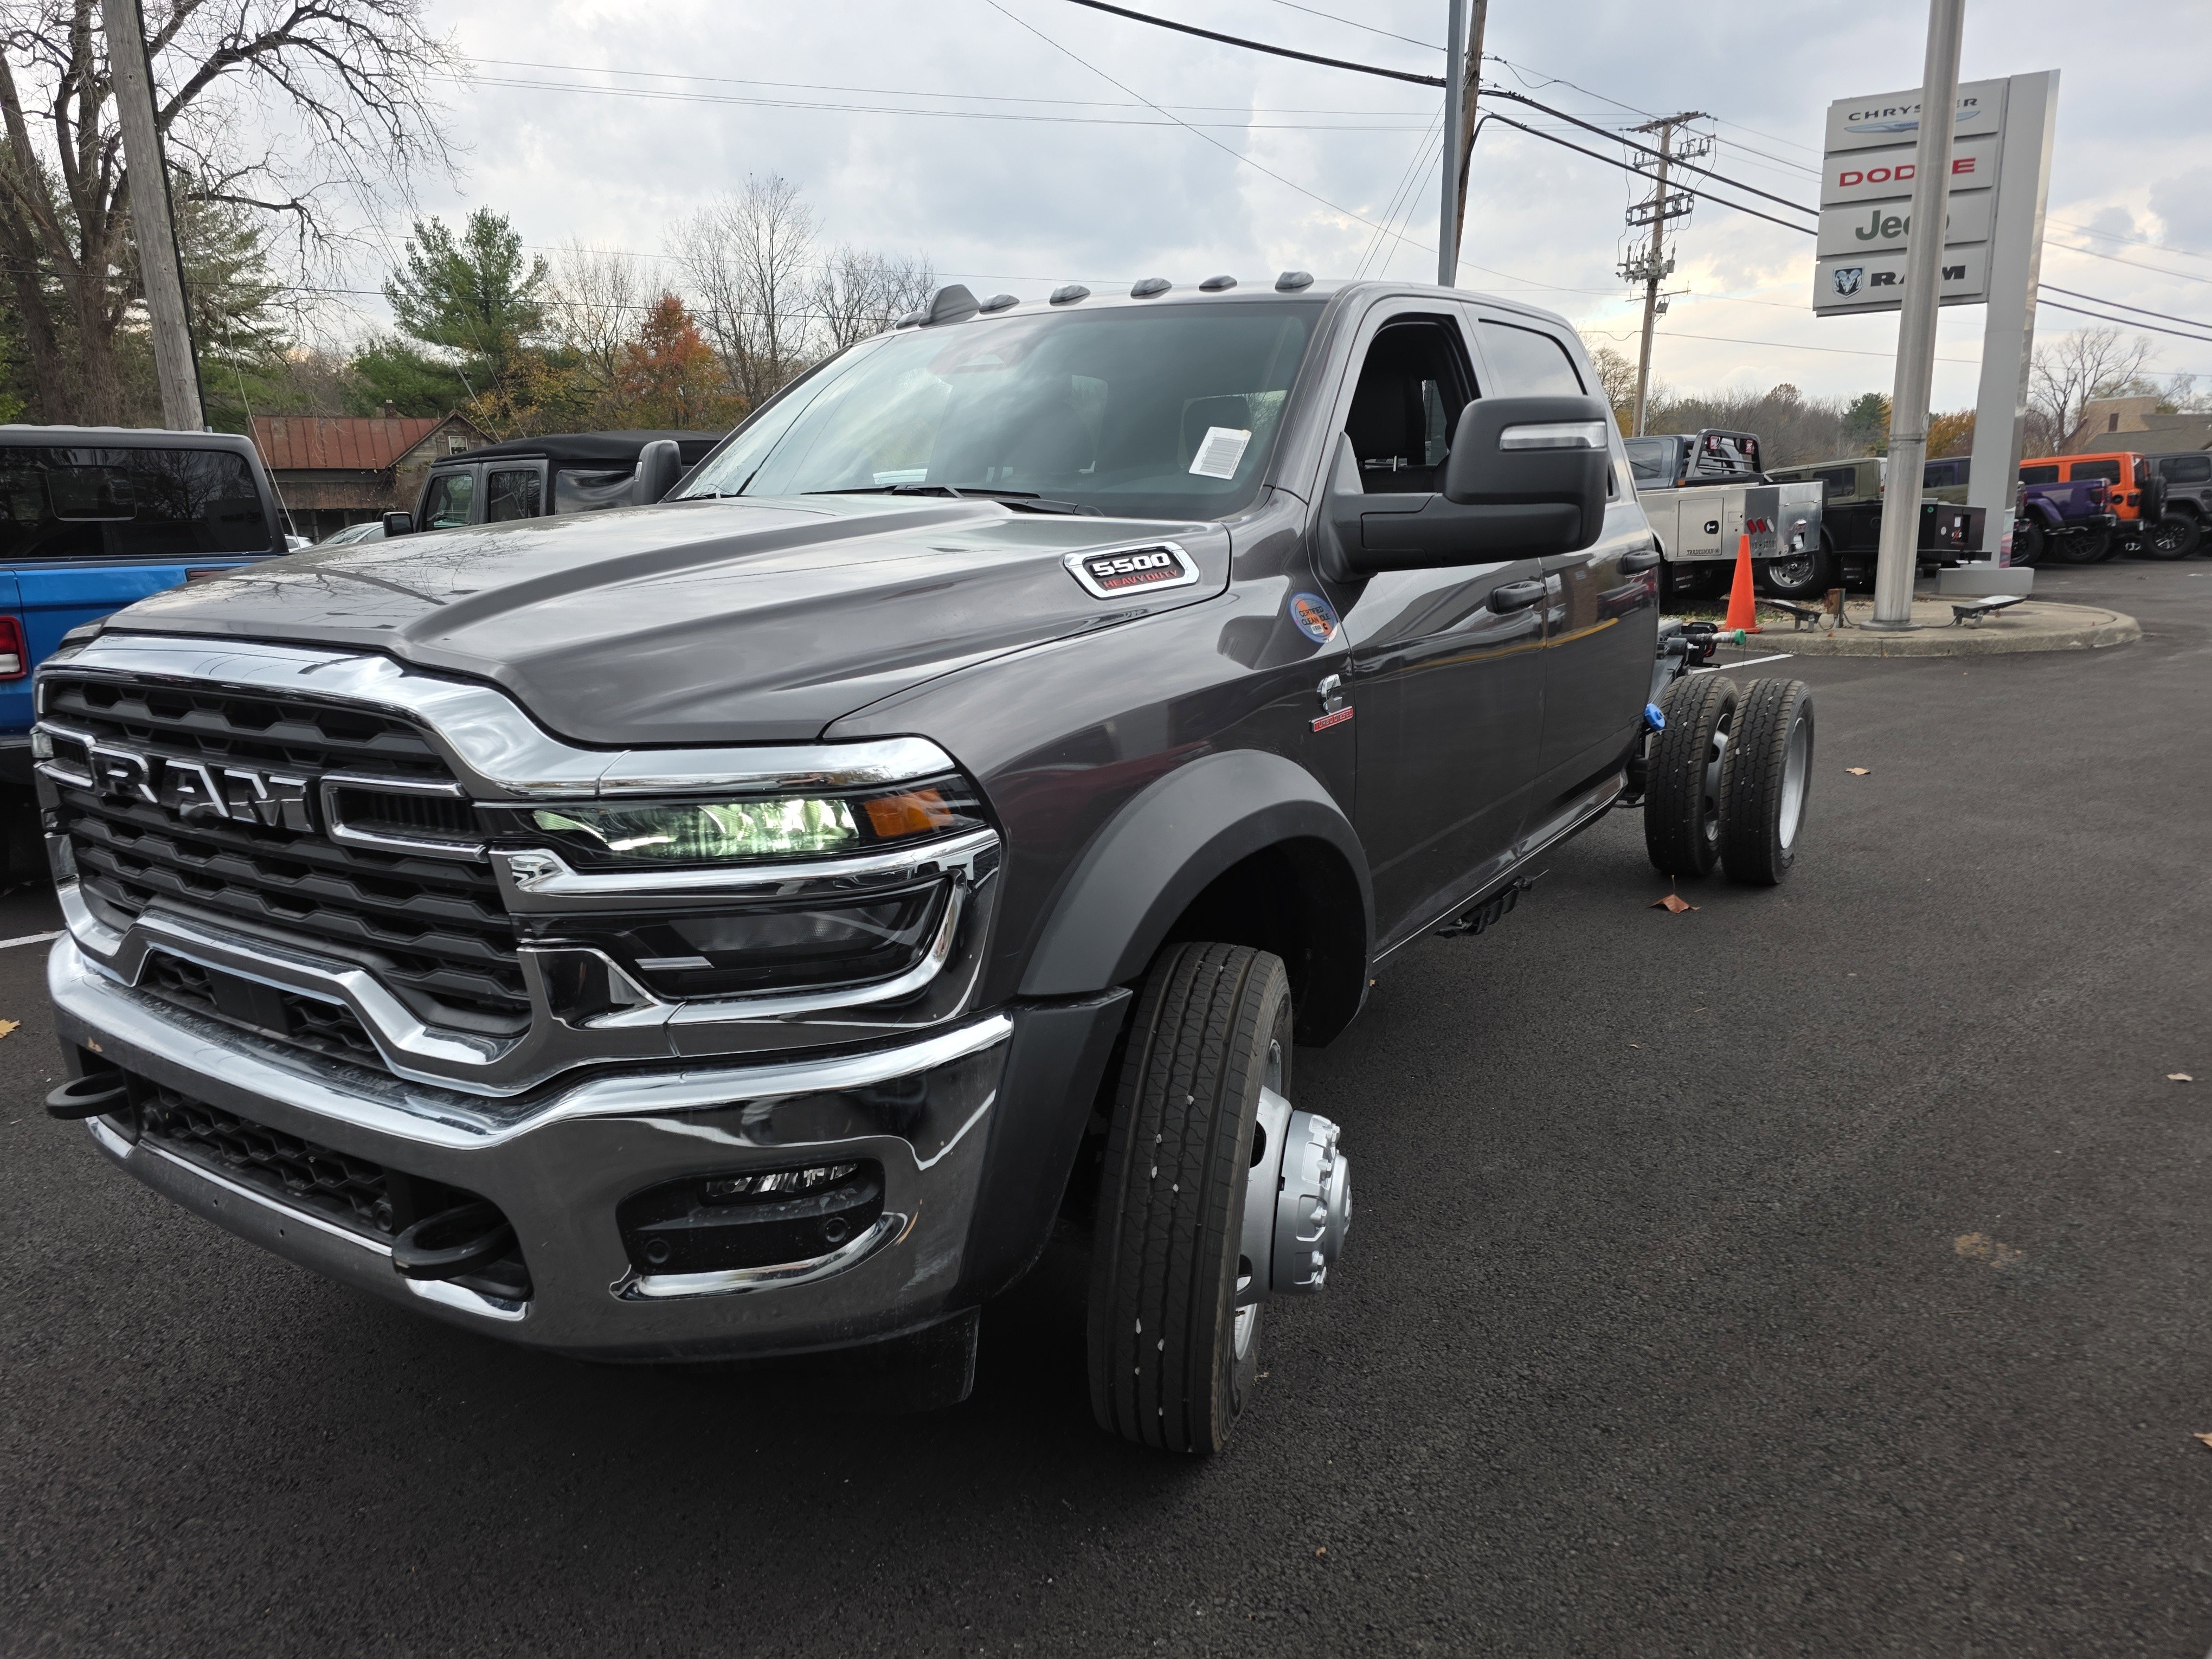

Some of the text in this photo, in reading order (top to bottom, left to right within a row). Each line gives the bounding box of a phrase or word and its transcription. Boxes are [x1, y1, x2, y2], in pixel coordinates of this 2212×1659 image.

[1848, 98, 1978, 120] CHRYSR
[1839, 158, 1976, 187] DODE
[1870, 265, 1966, 287] RM
[1091, 552, 1171, 577] 5500
[1102, 570, 1178, 588] HEAVY DUTY
[1299, 606, 1323, 616] CERTIFIED
[1301, 613, 1330, 626] CLEAN IDLE
[1314, 709, 1353, 729] TURBO DIESEL
[91, 743, 316, 833] RAM
